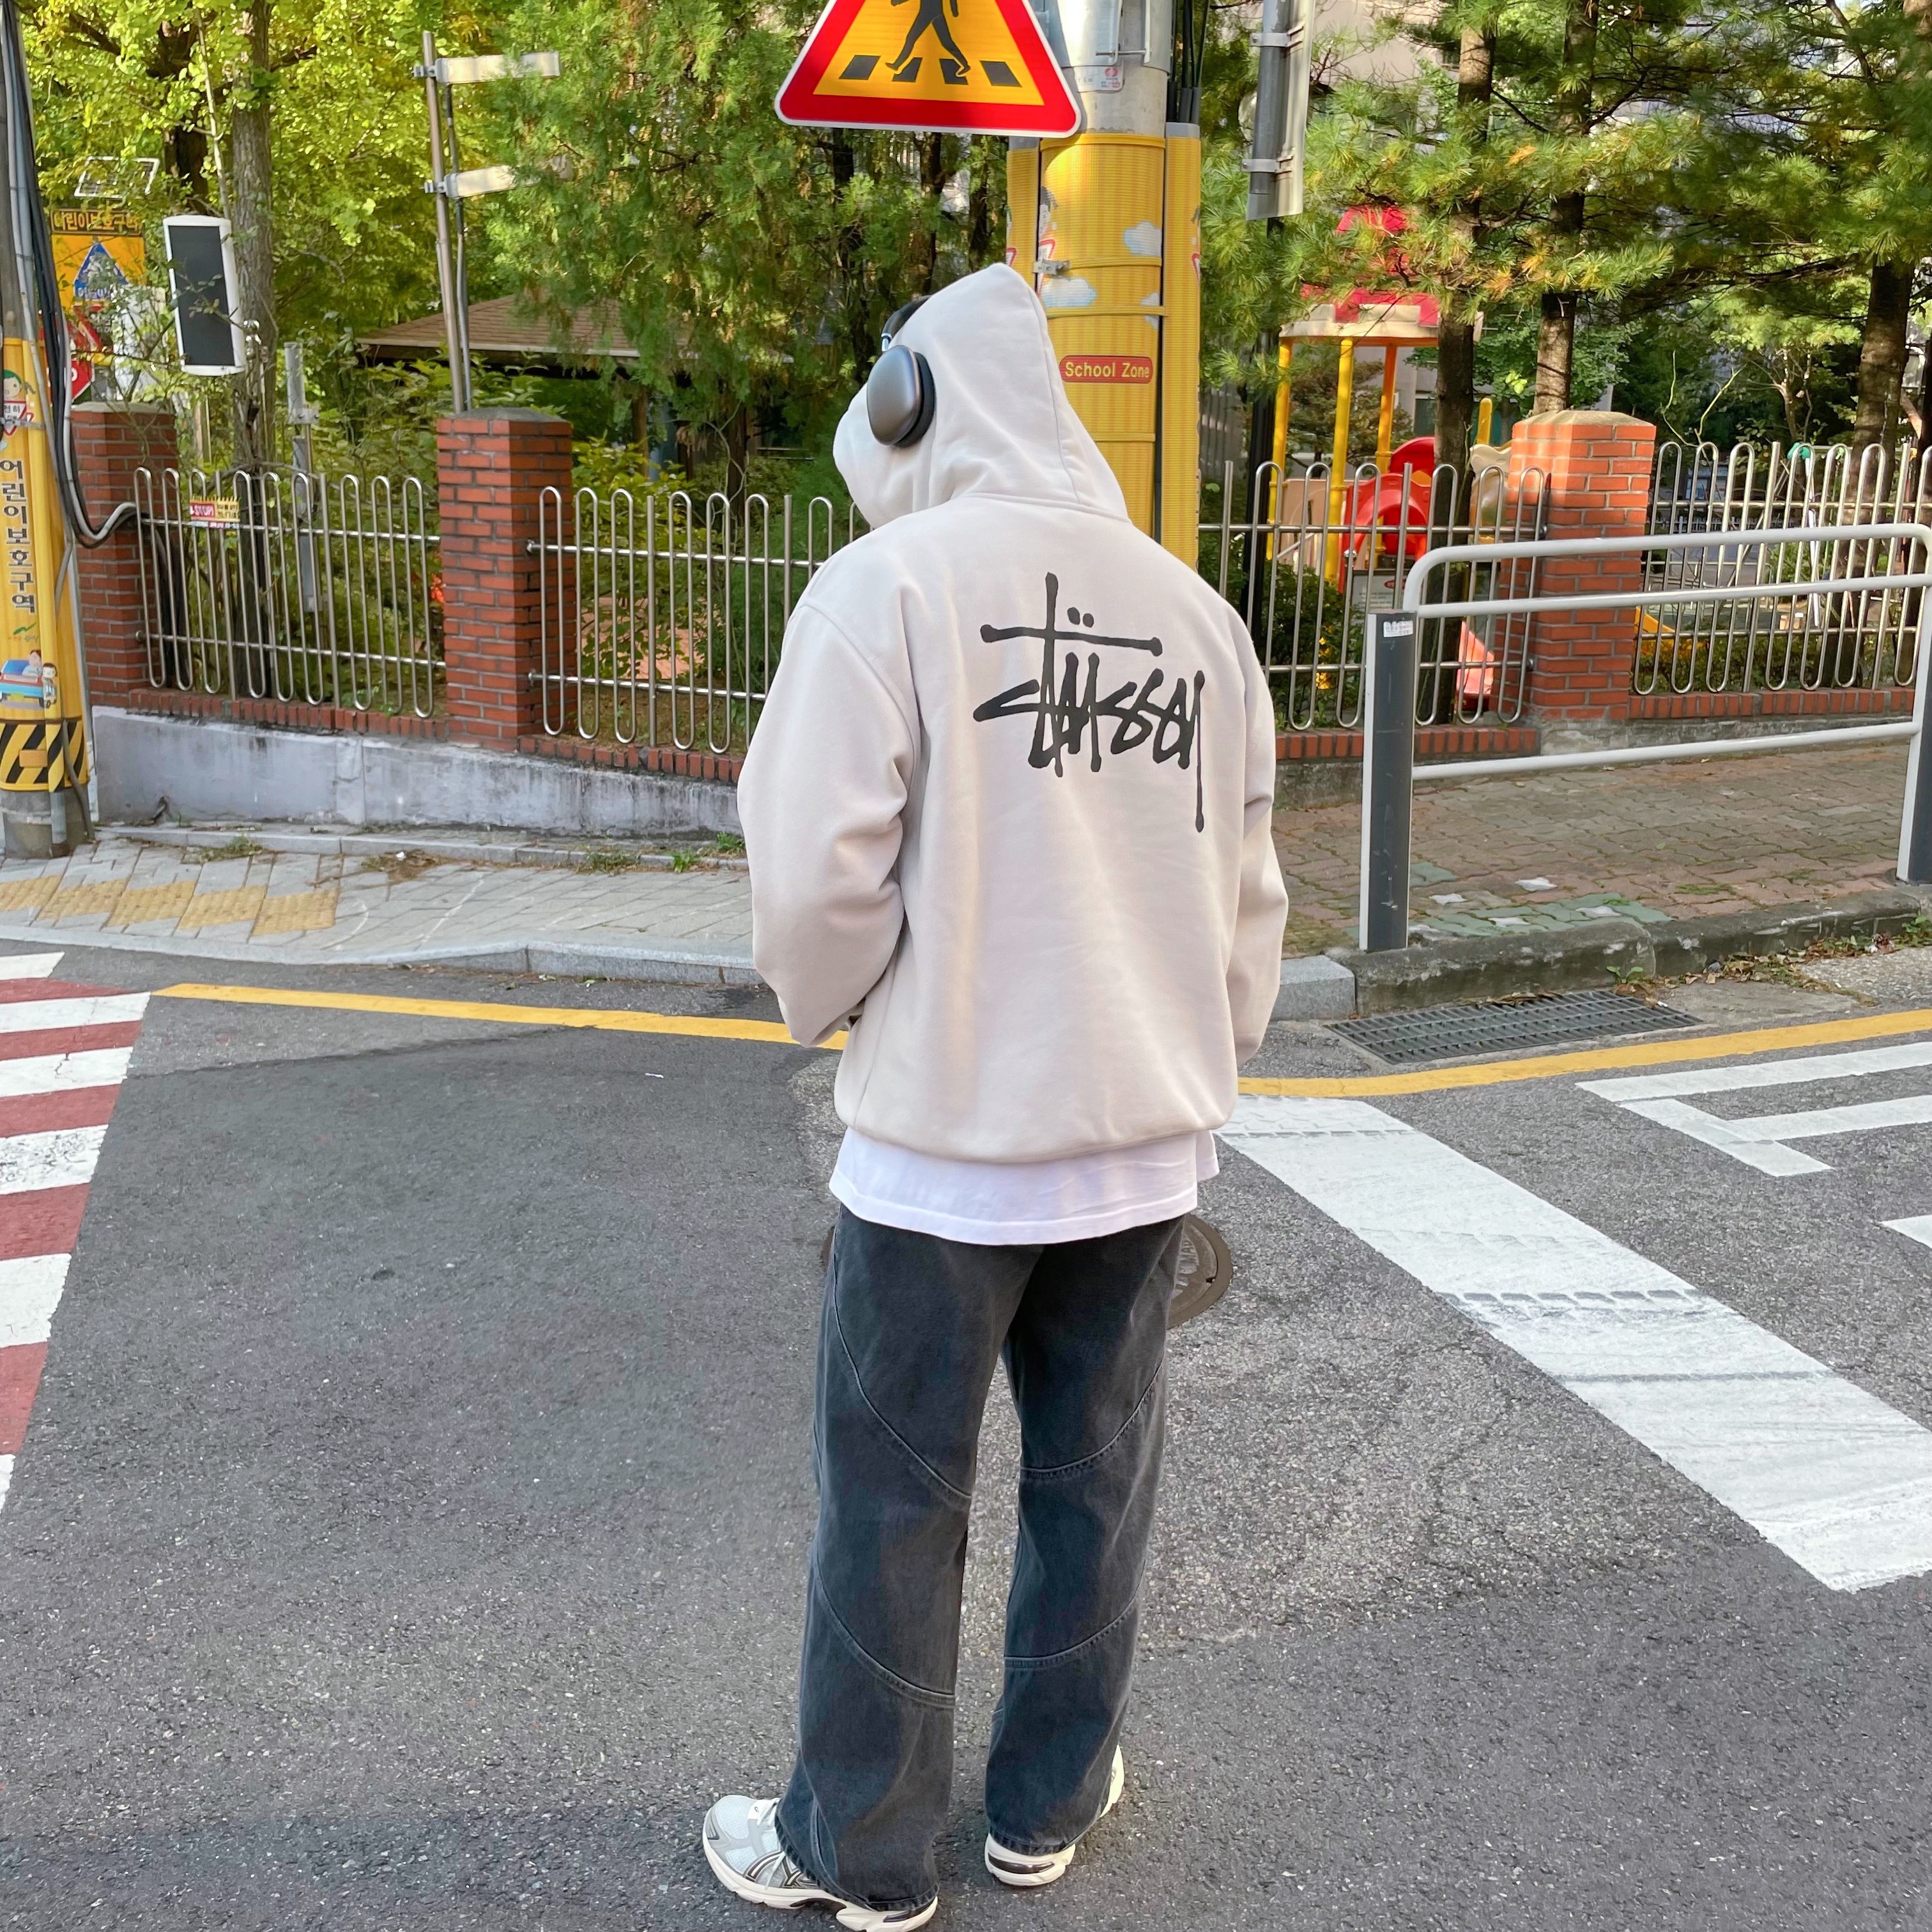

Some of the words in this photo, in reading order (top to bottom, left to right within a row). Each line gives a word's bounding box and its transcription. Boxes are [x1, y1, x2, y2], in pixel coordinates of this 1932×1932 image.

[1065, 362, 1116, 378] School
[1121, 362, 1150, 378] Zone
[0, 460, 35, 613] 어린이보호구역
